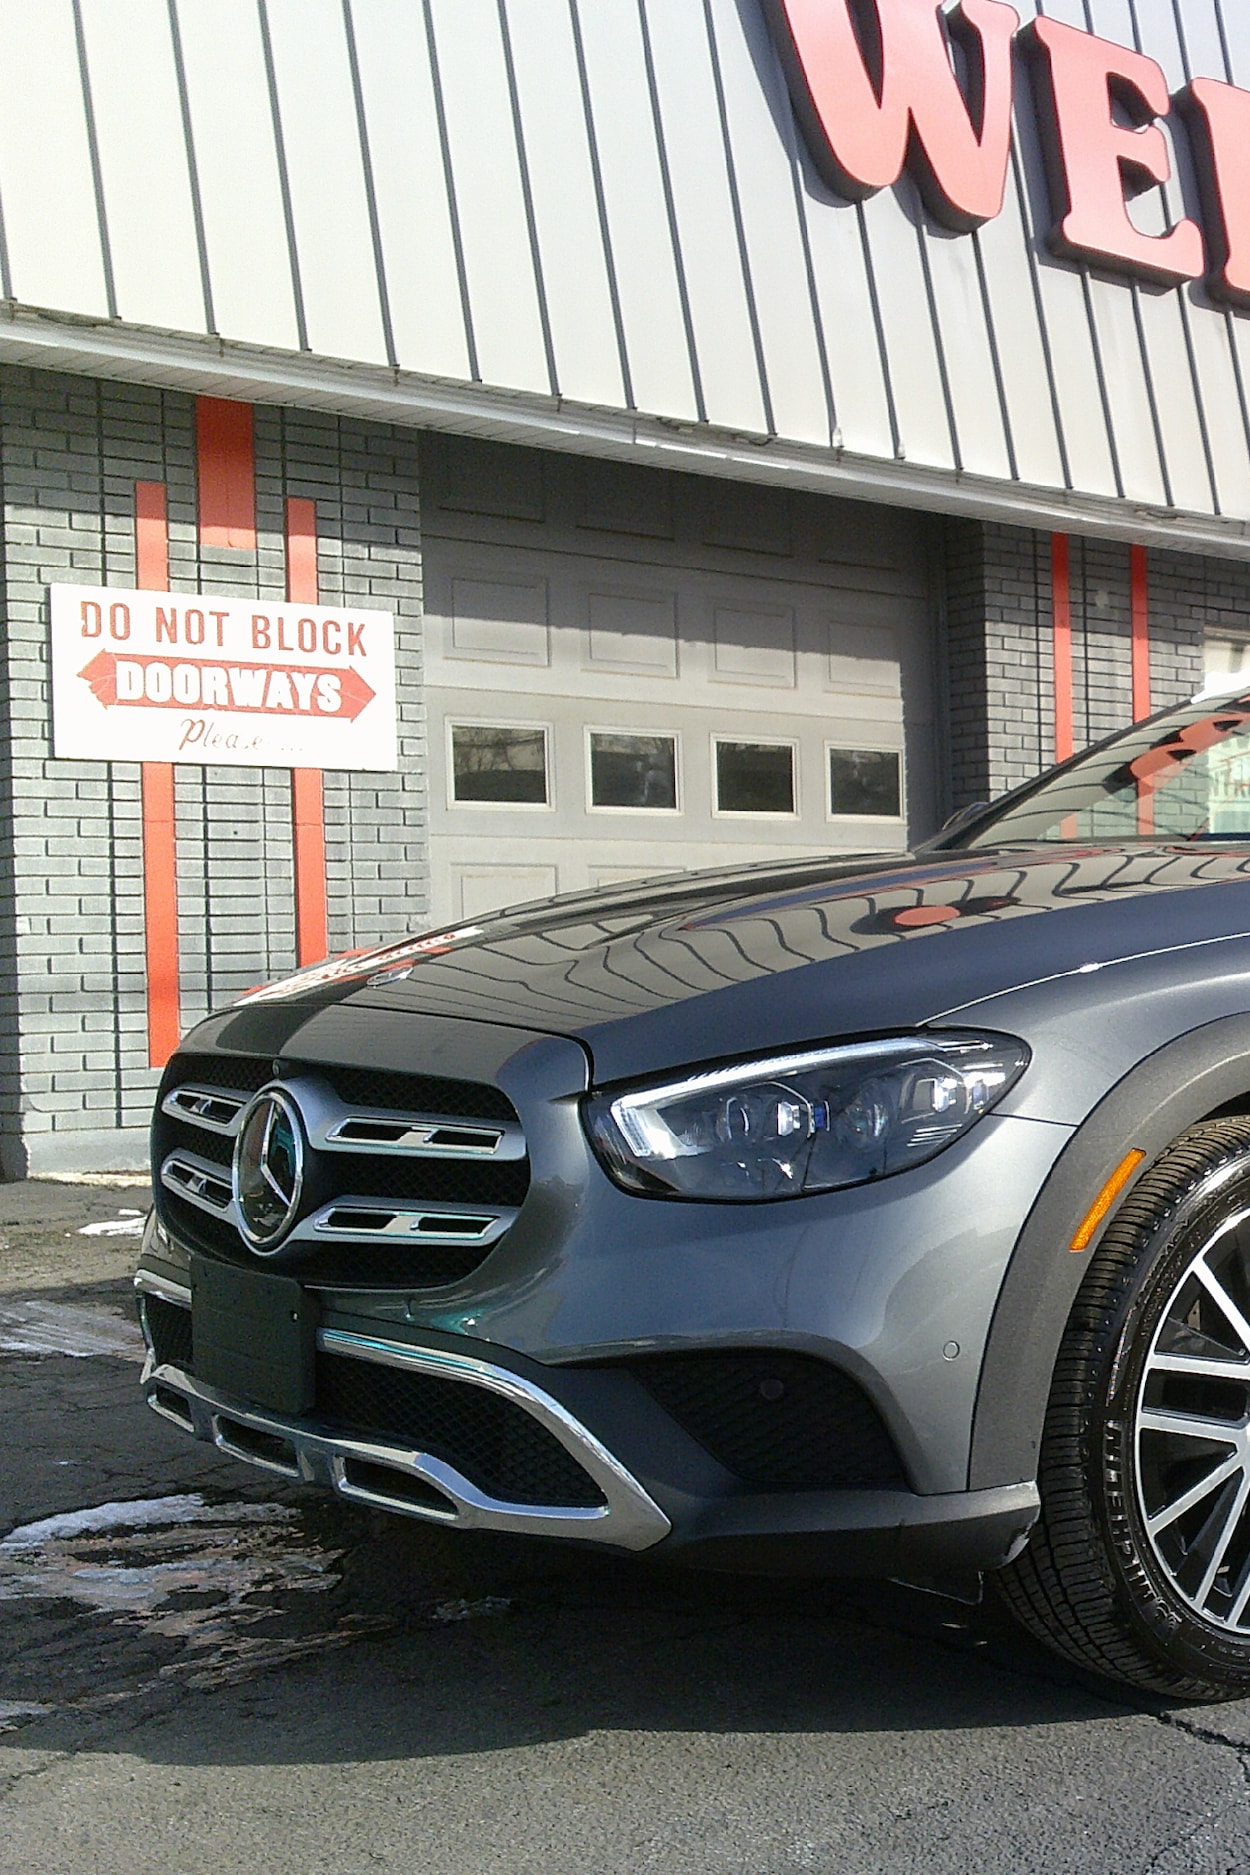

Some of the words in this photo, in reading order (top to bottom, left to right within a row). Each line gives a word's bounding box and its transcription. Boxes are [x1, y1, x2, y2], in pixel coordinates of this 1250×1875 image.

[80, 600, 131, 641] DO
[155, 607, 230, 648] NOT
[251, 614, 368, 657] BLOCK
[115, 659, 343, 713] DOORWAYS
[179, 718, 263, 751] Pleae
